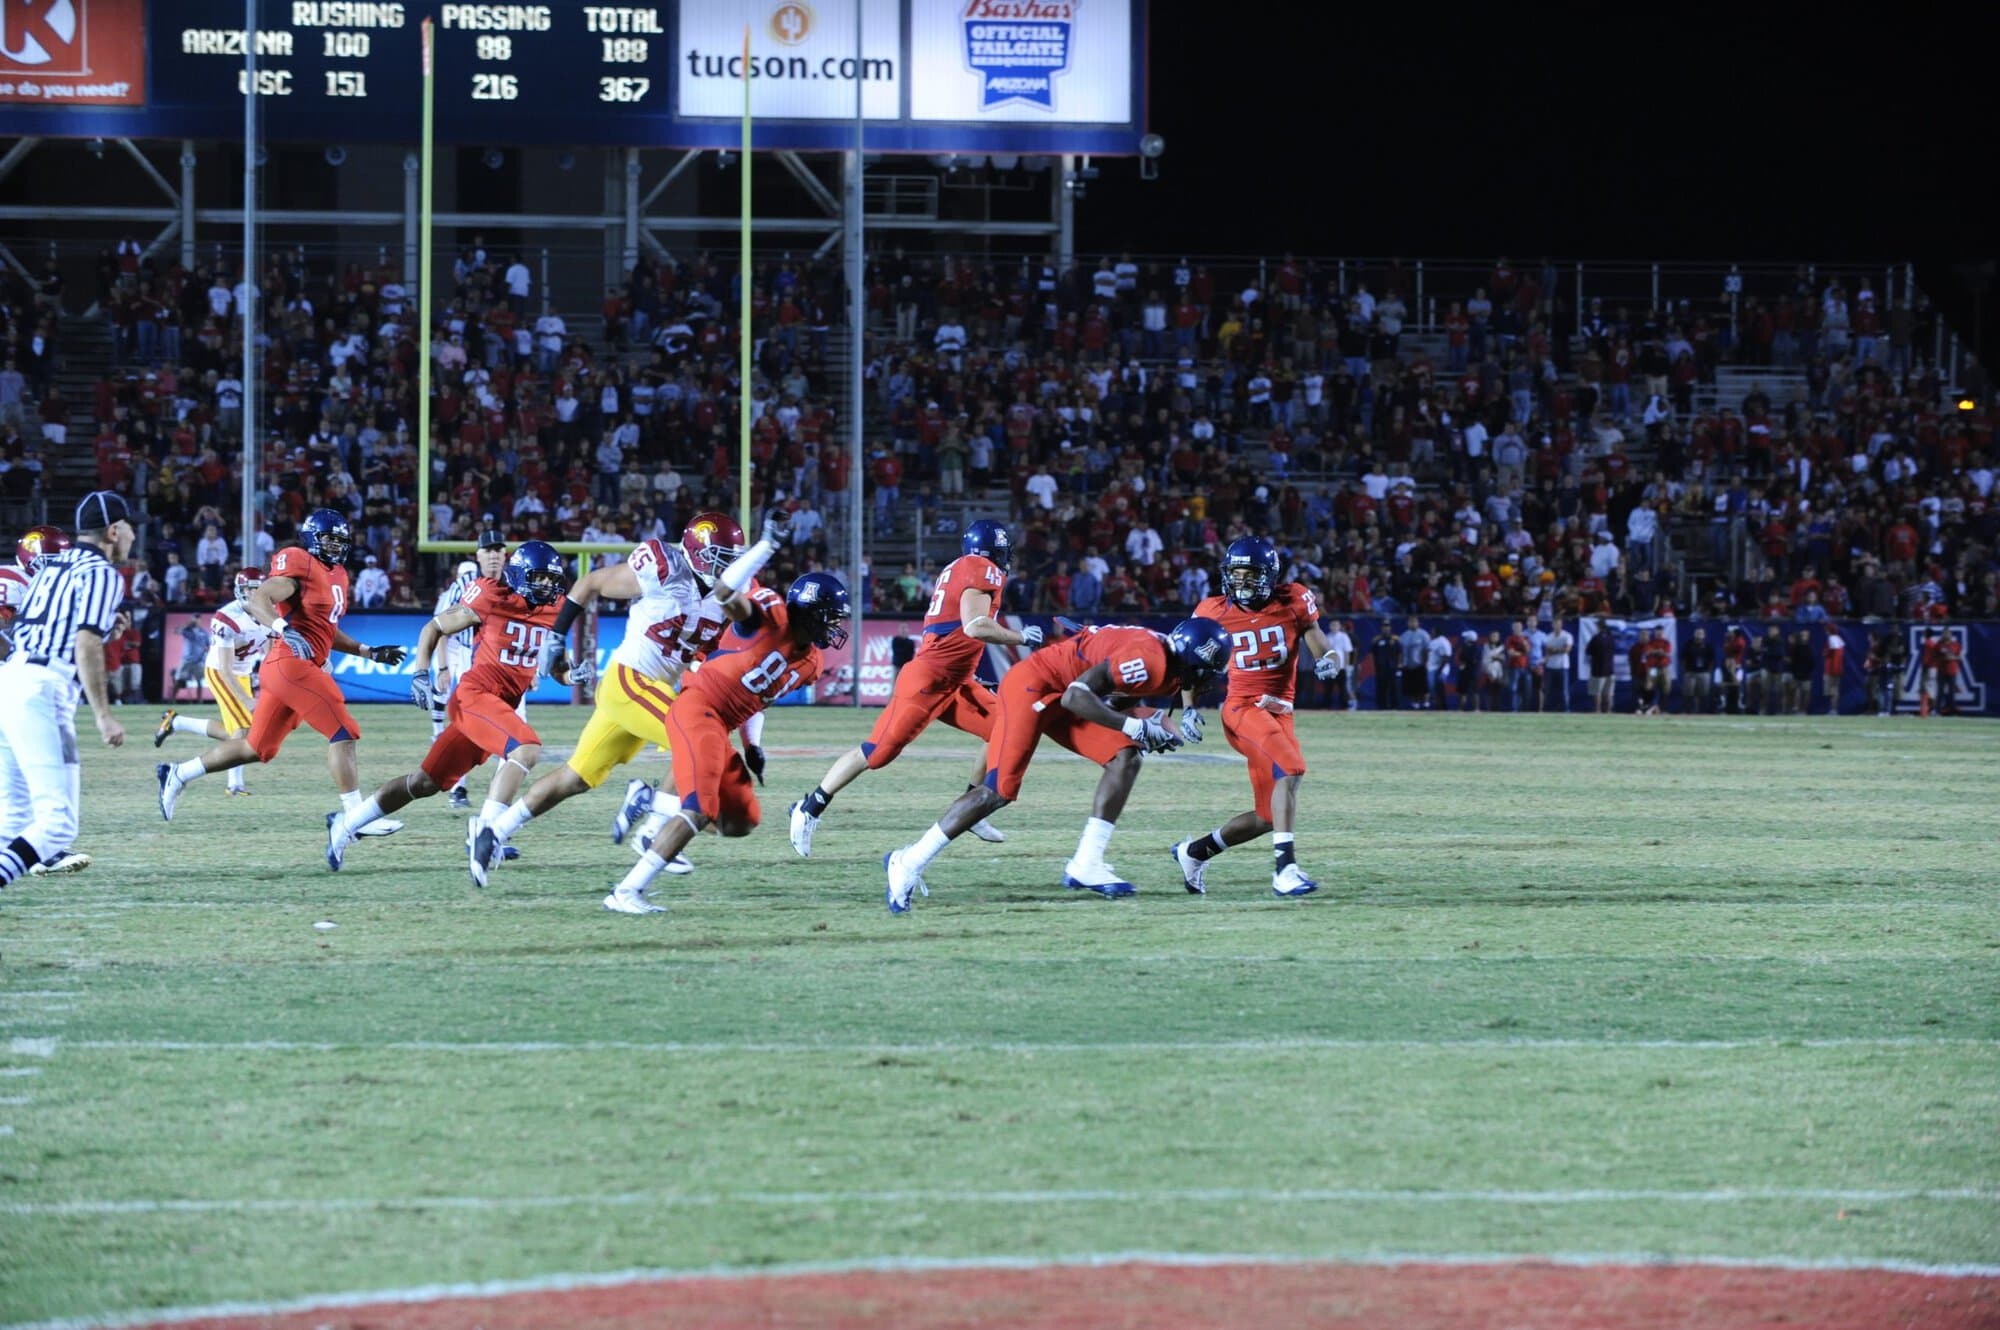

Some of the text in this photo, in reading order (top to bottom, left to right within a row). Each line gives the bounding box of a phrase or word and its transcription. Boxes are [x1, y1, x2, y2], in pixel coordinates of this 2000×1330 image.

[292, 1, 664, 33] RUSHING PASSING TOTAL
[323, 32, 370, 57] 100
[602, 38, 648, 63] 188
[970, 26, 1065, 40] OFFICIAL
[970, 41, 1065, 56] TAILGATE
[687, 50, 893, 80] tucson.com
[17, 81, 41, 96] do
[43, 84, 74, 98] you
[76, 82, 129, 96] need?
[238, 70, 650, 102] USC 151 216 367
[276, 553, 287, 571] 8
[984, 565, 1003, 587] 45
[328, 584, 345, 624] 8
[751, 586, 782, 612] 81
[499, 619, 550, 668] 38
[1231, 624, 1289, 672] 23
[740, 649, 801, 701] 81
[1118, 656, 1150, 685] 89
